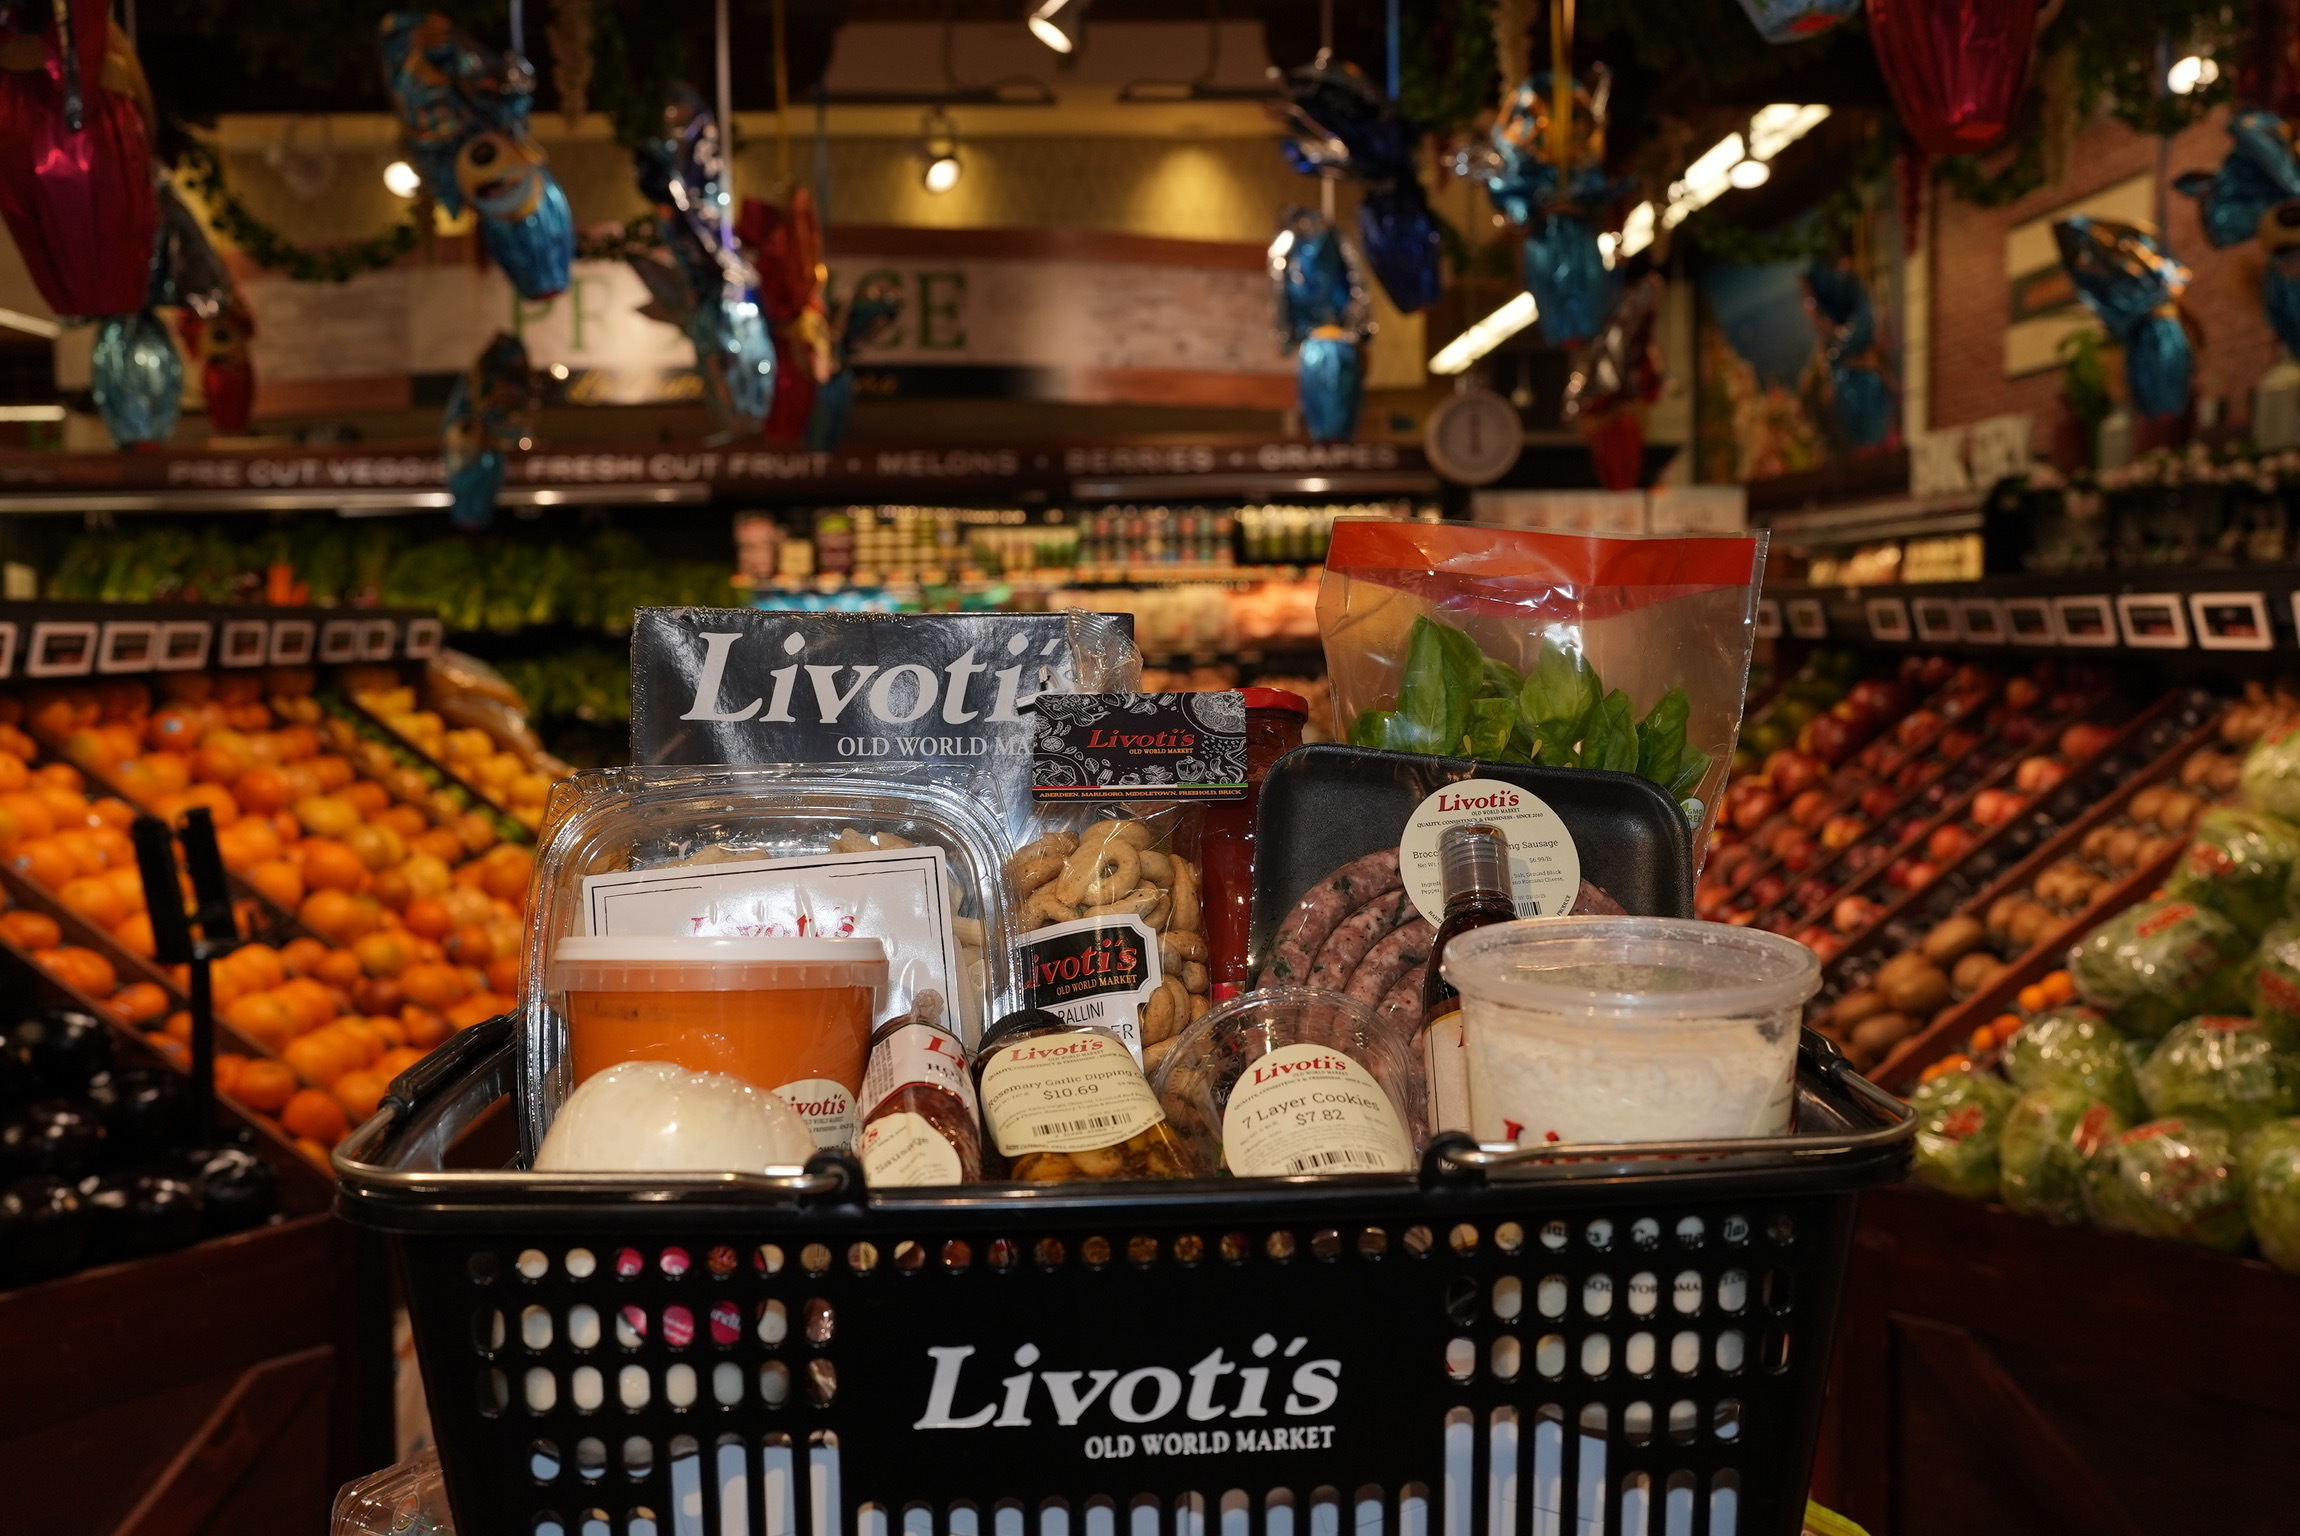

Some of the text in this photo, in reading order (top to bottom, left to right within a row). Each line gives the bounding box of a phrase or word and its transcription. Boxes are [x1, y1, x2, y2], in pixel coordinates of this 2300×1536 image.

[246, 457, 319, 487] CUT
[526, 454, 643, 481] FRESH
[650, 453, 721, 481] CUT
[728, 452, 826, 479] FRUIT
[877, 450, 1020, 476] MELONS
[1065, 447, 1214, 473] BERRIES
[1257, 445, 1398, 470] GRAPES
[680, 631, 1060, 724] Livoti'
[837, 736, 889, 757] OLD
[895, 735, 987, 757] WORLD
[1087, 728, 1195, 748] Livoti's
[1438, 790, 1519, 812] Livoti's
[1412, 851, 1439, 859] Brocc
[1522, 840, 1559, 849] Sausage
[1023, 939, 1138, 990] ivoti's
[1056, 974, 1138, 996] OLD WORLD MARKET
[1058, 1001, 1105, 1025] RALLINI
[1010, 1038, 1104, 1062] Livoti's
[1253, 1056, 1346, 1085] Livoti's
[987, 1080, 1041, 1110] Rosemary
[1045, 1075, 1082, 1087] Garlic
[1084, 1068, 1133, 1081] Dipping
[1043, 1084, 1099, 1101] $10.69
[1242, 1092, 1380, 1129] 7 Layer Cookies
[1295, 1108, 1345, 1126] $7.82
[913, 1332, 1342, 1430] Livoti's
[1085, 1425, 1336, 1460] OLD WORLD MARKET
